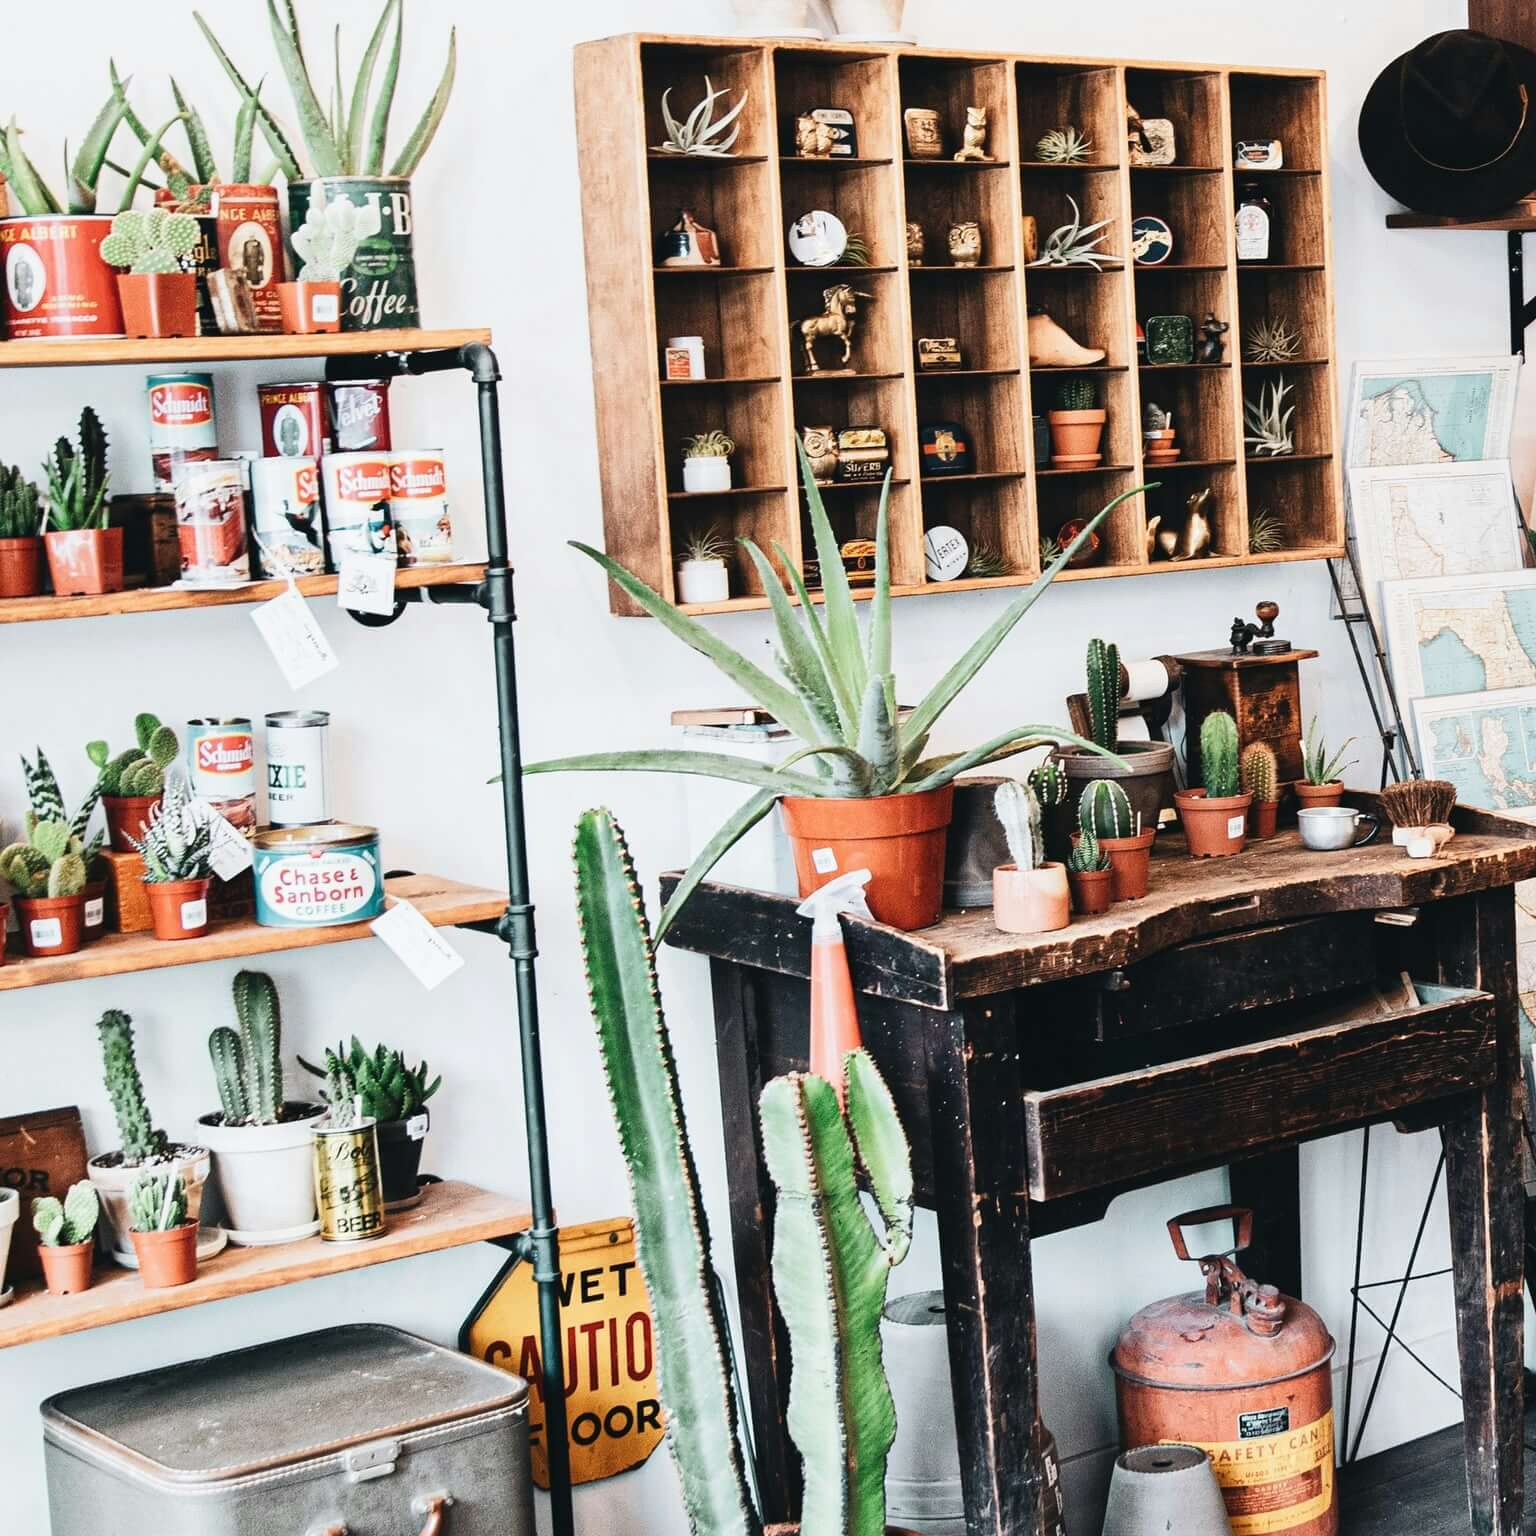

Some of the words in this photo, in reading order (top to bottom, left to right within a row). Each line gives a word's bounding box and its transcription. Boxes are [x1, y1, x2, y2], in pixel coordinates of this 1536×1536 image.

[20, 225, 78, 241] ALBERT
[339, 279, 407, 325] Coffee
[151, 390, 209, 415] Schmidt
[845, 461, 881, 473] SUPERB
[390, 465, 445, 493] Schmidt
[279, 869, 344, 886] Chase
[274, 884, 364, 905] Sanborn
[295, 902, 345, 917] COFFEE
[336, 1212, 381, 1233] BEER
[528, 1399, 662, 1446] FOOR
[1207, 1443, 1278, 1462] SAFETY
[1289, 1428, 1319, 1449] CAN
